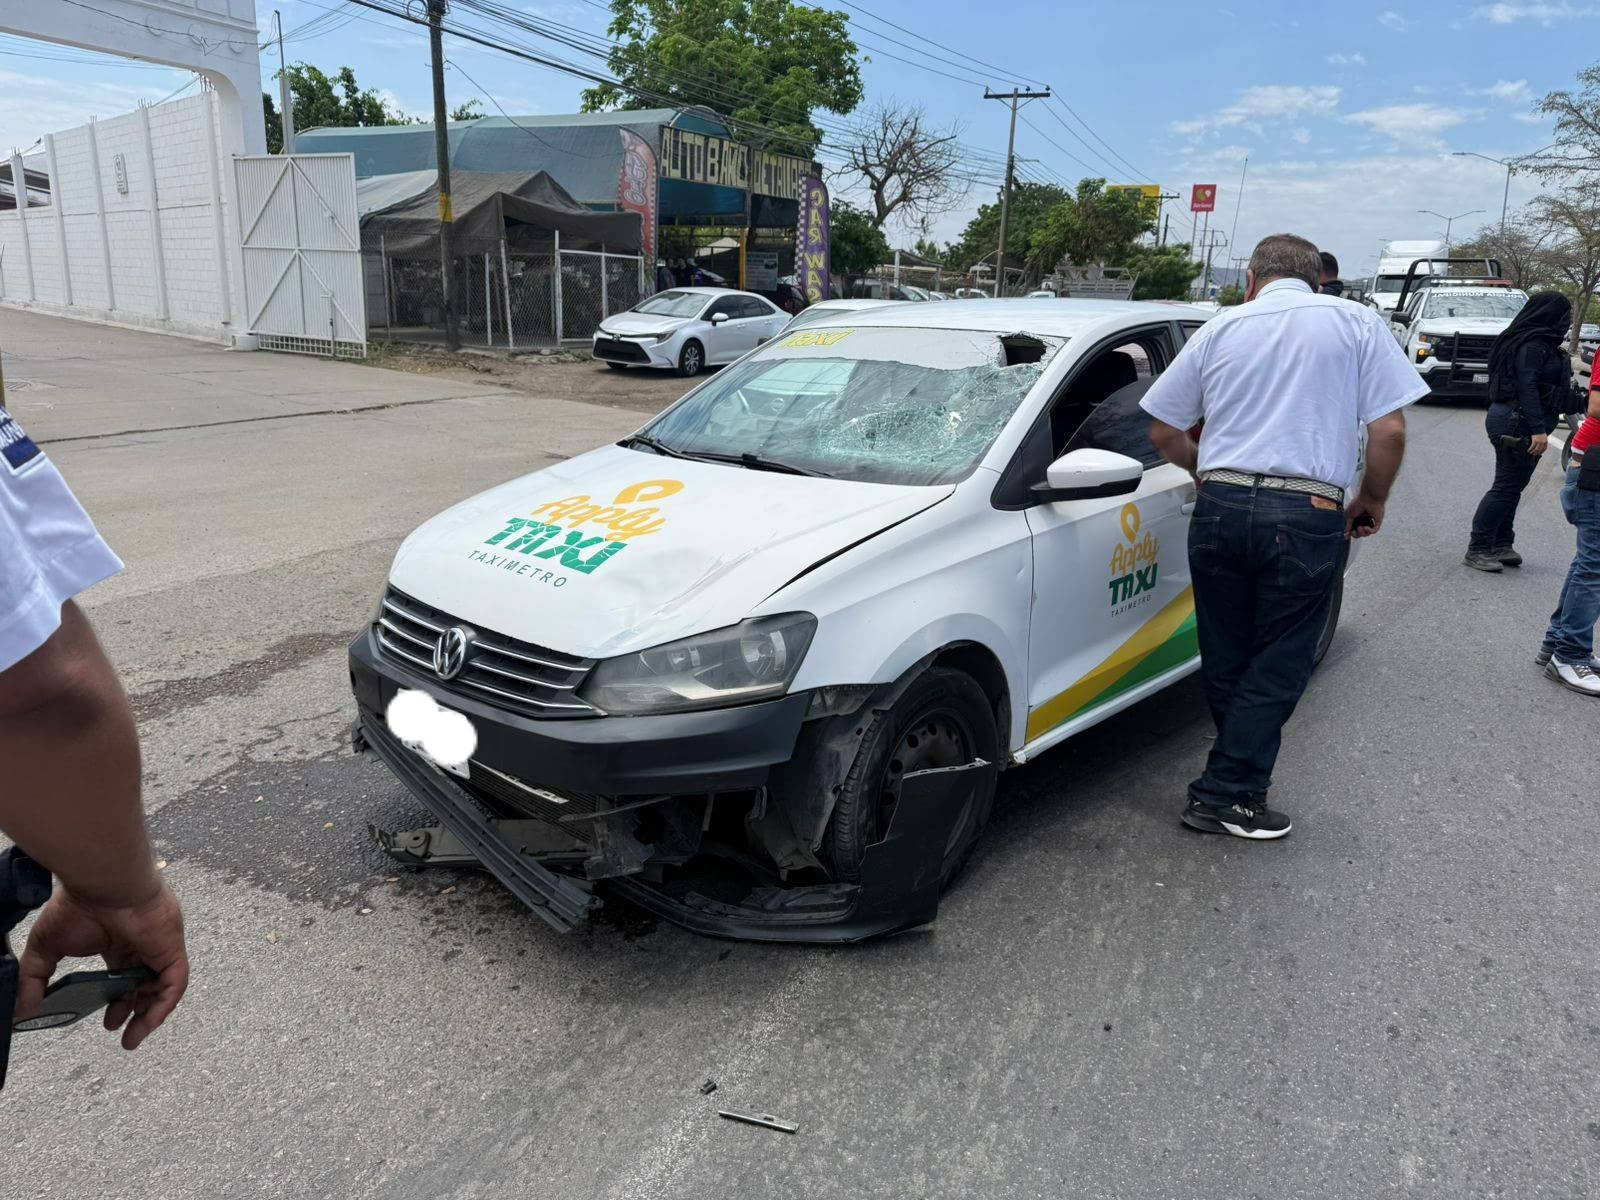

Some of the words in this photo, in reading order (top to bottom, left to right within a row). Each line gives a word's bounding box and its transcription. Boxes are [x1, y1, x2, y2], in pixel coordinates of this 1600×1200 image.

[530, 495, 666, 541] Apply
[467, 550, 567, 588] TAXIMETRO
[1110, 531, 1160, 576] Apply
[1111, 594, 1151, 617] TAXIMETRO
